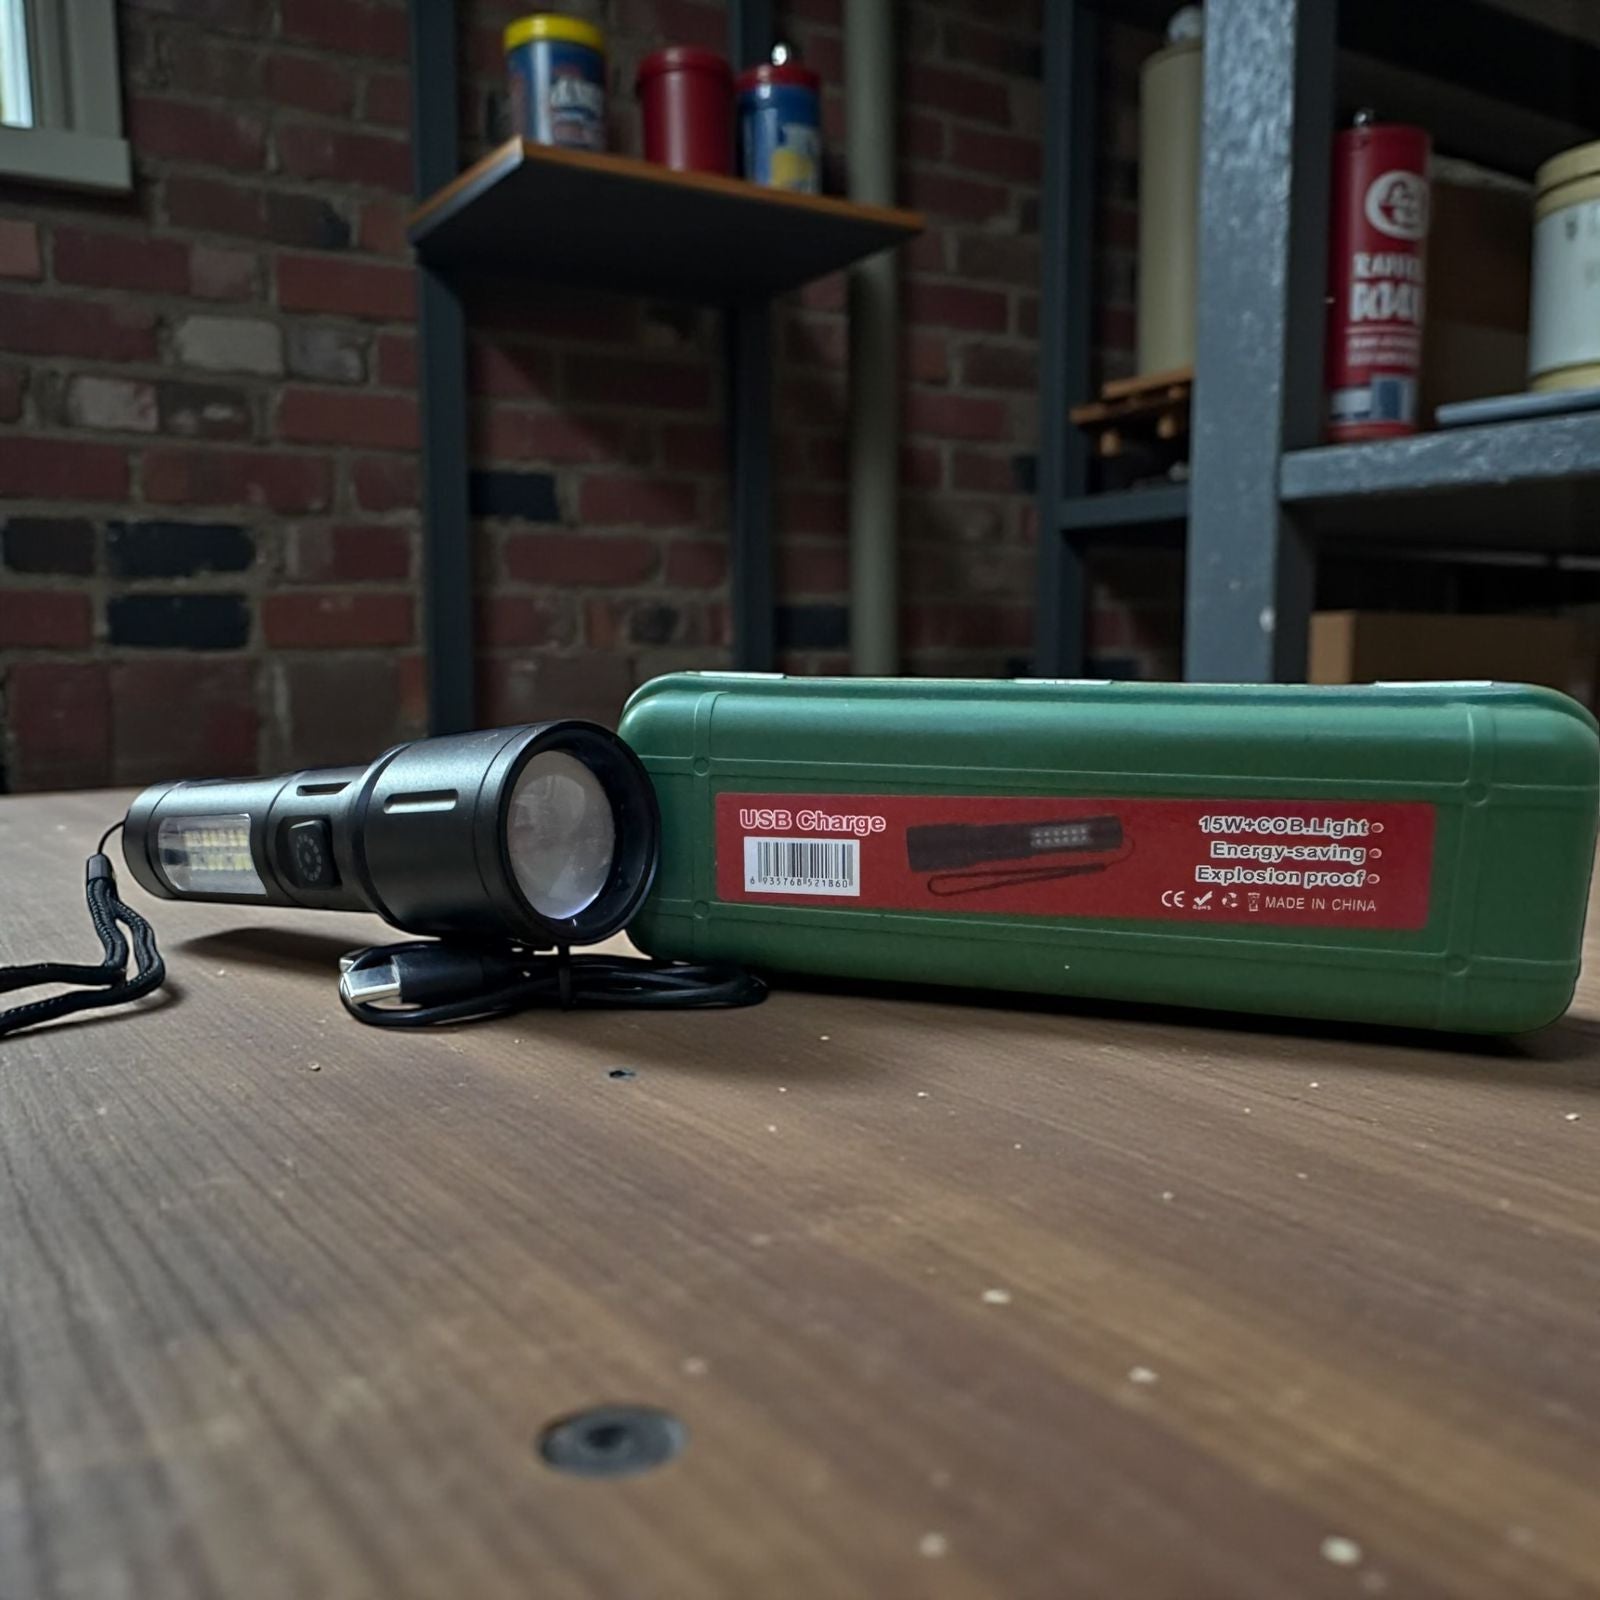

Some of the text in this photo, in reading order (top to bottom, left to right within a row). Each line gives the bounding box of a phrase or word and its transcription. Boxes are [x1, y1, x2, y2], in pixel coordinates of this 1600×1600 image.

[740, 809, 886, 837] USB Charge
[1199, 815, 1369, 838] 15W+COB.Light
[1211, 841, 1366, 865] Energy-saving
[1196, 865, 1366, 889] Explosion proof
[1161, 890, 1185, 908] CE
[1265, 896, 1377, 911] MADE IN CHINA
